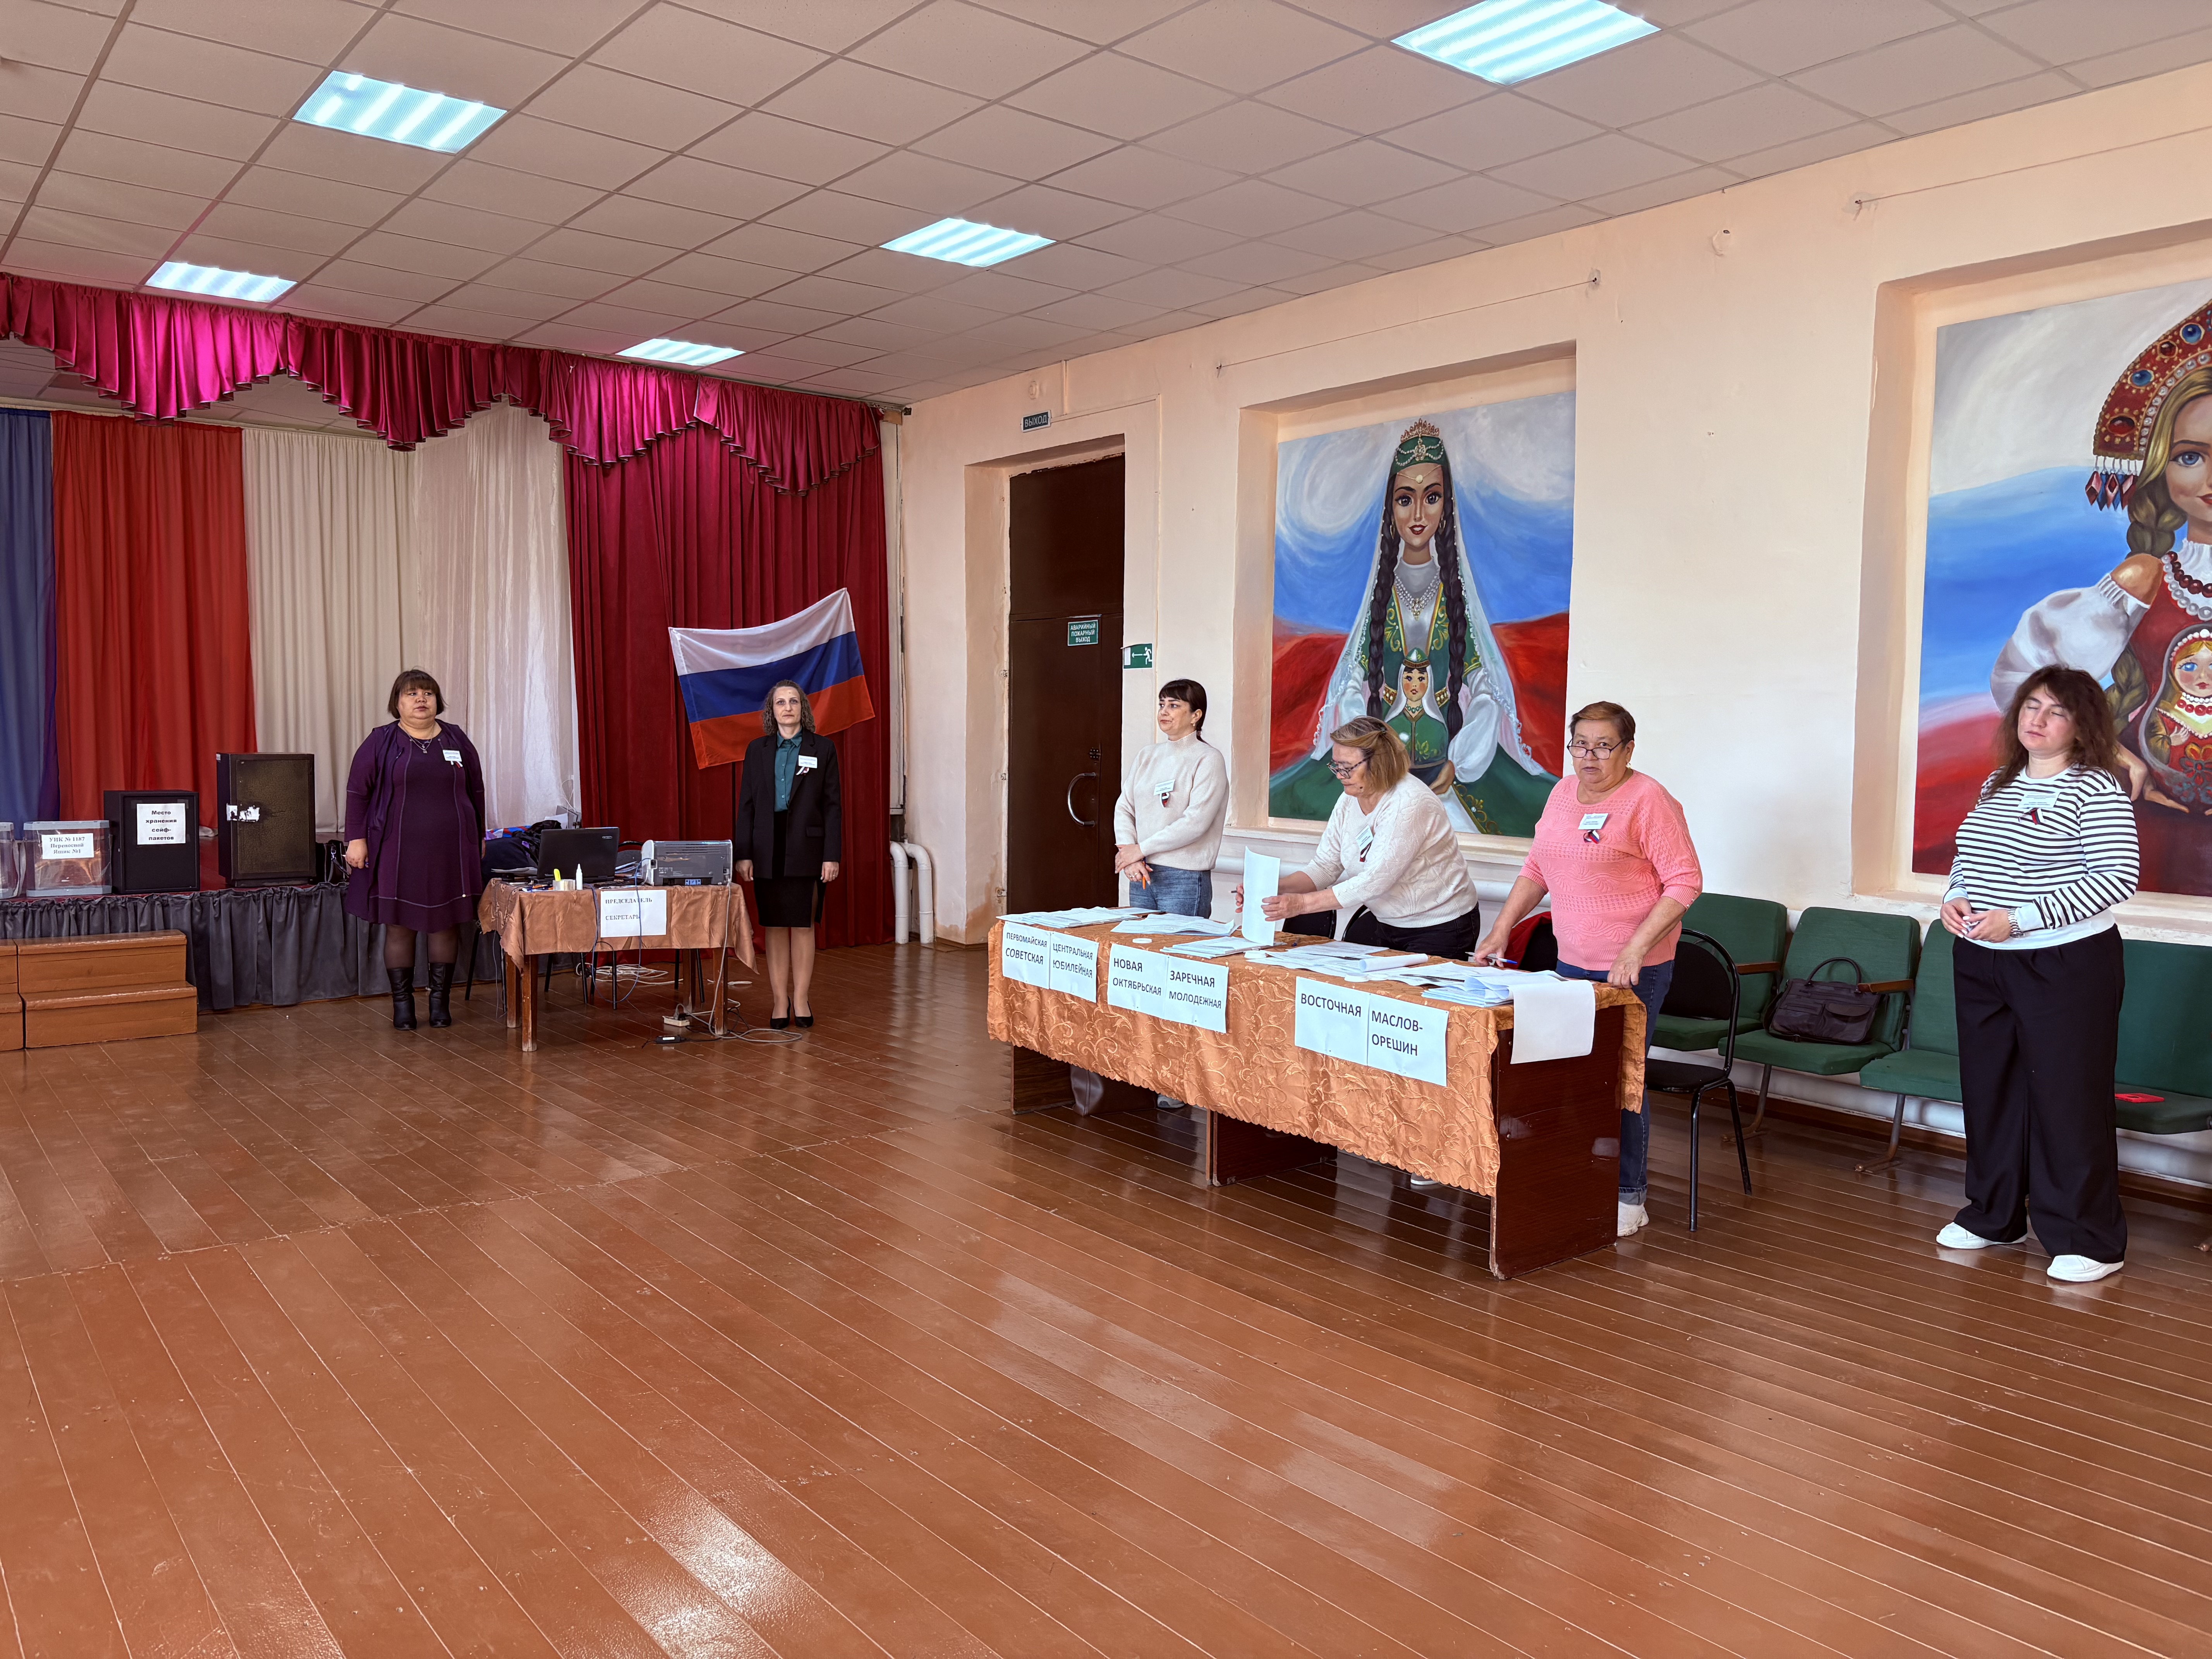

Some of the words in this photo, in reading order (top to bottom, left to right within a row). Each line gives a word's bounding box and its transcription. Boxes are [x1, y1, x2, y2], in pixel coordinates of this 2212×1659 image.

[1025, 415, 1047, 427] ВЫХОД
[1070, 622, 1096, 630] АВАРИЙНЫЙ
[1006, 932, 1047, 948] ПЕРВОМАЙСКАЯ
[1006, 948, 1043, 965] СОВЕТСКАЯ
[1053, 943, 1093, 960] ЦЕНТРАЛЬНАЯ
[1053, 960, 1092, 978] ЮБИЛЕЙНАЯ
[1114, 958, 1142, 972] НОВАЯ
[1113, 977, 1161, 996] ОКТЯБРЬСКАЯ
[1170, 970, 1214, 988] ЗАРЕЧНАЯ
[1169, 991, 1221, 1009] МОЛОДЕЖНАЯ
[1301, 993, 1361, 1017] ВОСТОЧНАЯ
[1372, 1010, 1423, 1032] МАСЛОВ-
[1372, 1034, 1417, 1056] ОРЕШИН
